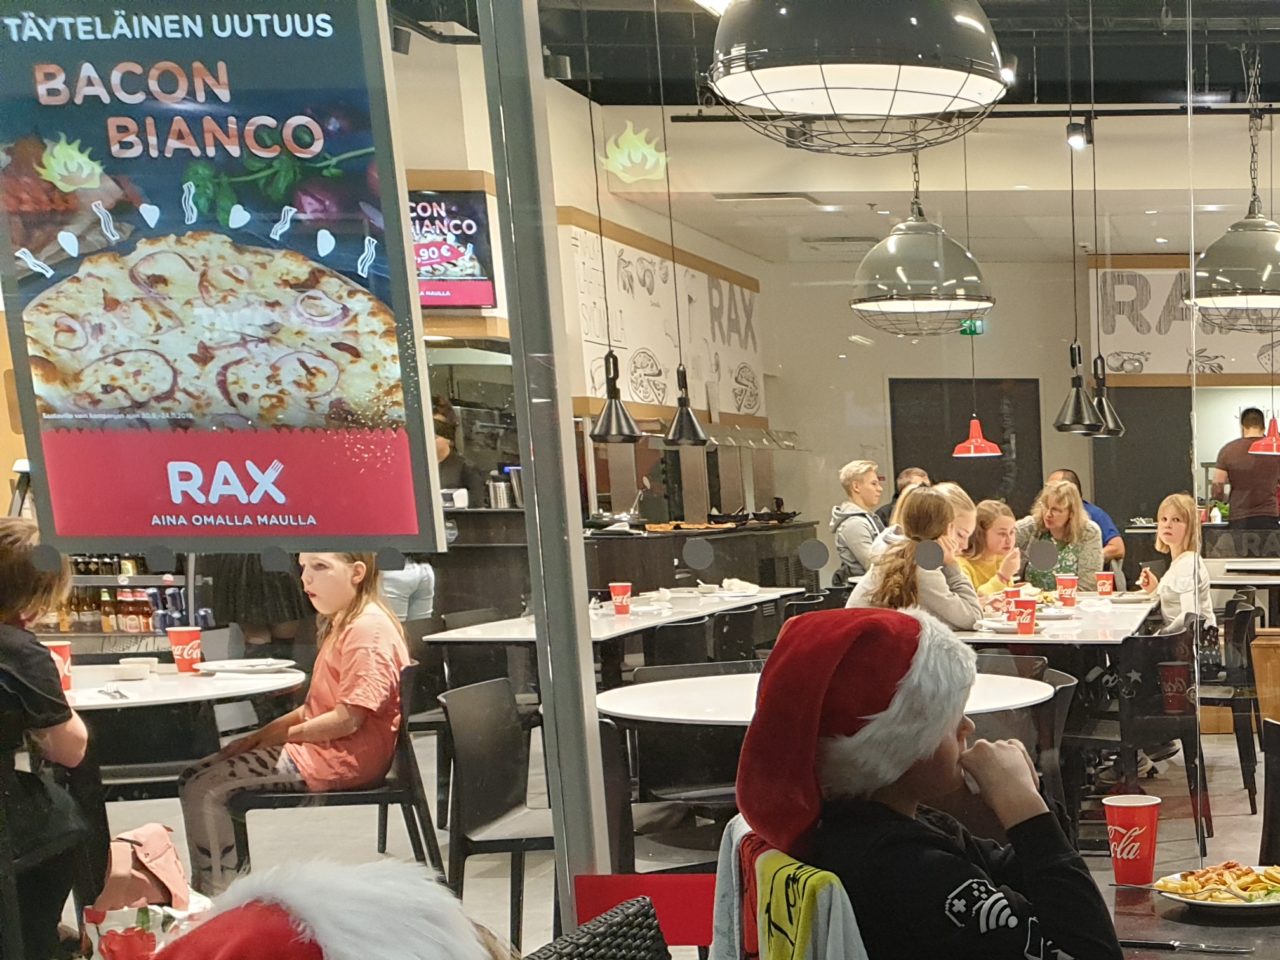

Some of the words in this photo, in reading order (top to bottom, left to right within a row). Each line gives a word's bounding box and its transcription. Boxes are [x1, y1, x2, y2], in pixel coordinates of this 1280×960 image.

[3, 10, 204, 42] TÄYTELÄINEN
[211, 13, 334, 38] UUTUUS
[34, 60, 231, 106] BACON
[107, 114, 325, 159] BIANCO
[409, 202, 446, 217] CON
[410, 219, 477, 234] IANCO
[707, 275, 757, 352] RAX
[167, 459, 286, 504] RAX
[151, 514, 188, 526] AINA
[192, 514, 252, 526] OMALLA
[257, 514, 317, 526] MAULLA
